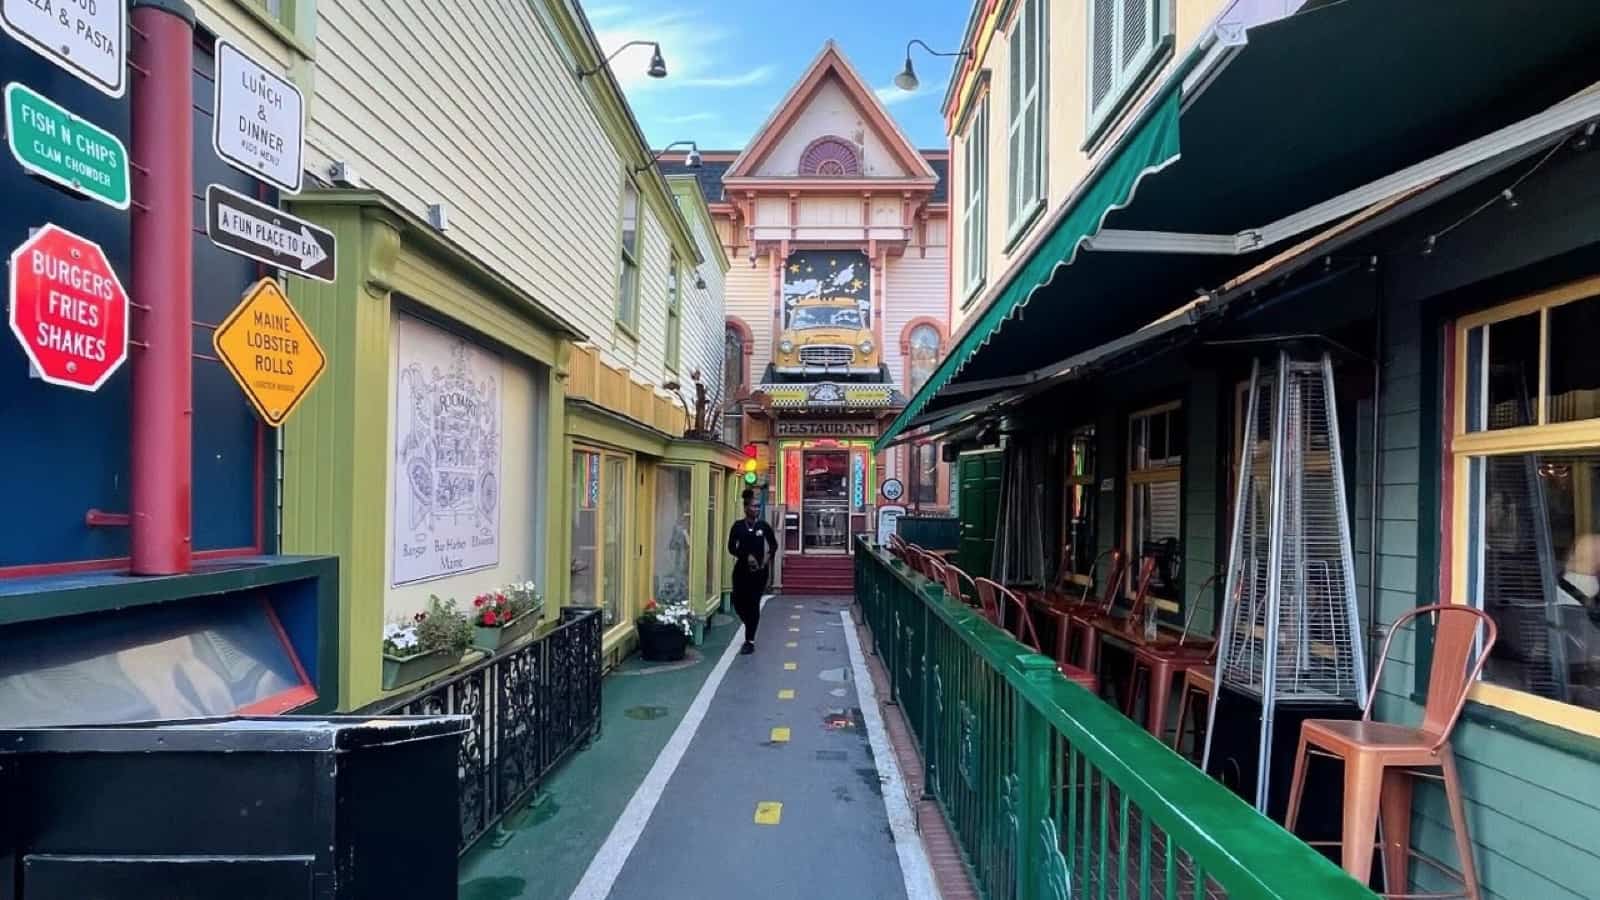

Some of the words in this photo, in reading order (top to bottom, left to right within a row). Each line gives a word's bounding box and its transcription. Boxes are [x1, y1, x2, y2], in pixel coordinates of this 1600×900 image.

[59, 8, 70, 28] &
[77, 19, 115, 58] PASTA
[242, 71, 282, 110] LUNCH
[257, 104, 267, 122] &
[22, 103, 55, 137] FISH
[61, 124, 71, 145] N
[76, 134, 117, 169] CHIPS
[239, 115, 284, 154] DINNER
[33, 140, 62, 164] CLAM
[65, 155, 111, 187] CHOWDER
[222, 211, 229, 227] A
[233, 215, 252, 237] FUN
[256, 224, 284, 248] PLACE
[288, 236, 298, 252] TO
[32, 249, 114, 300] BURGERS
[48, 290, 99, 328] FRIES
[254, 310, 290, 333] MAINE
[36, 322, 106, 362] SHAKES
[247, 331, 300, 355] LOBSTER
[255, 355, 294, 376] ROLLS
[778, 423, 874, 434] RESTAURANT
